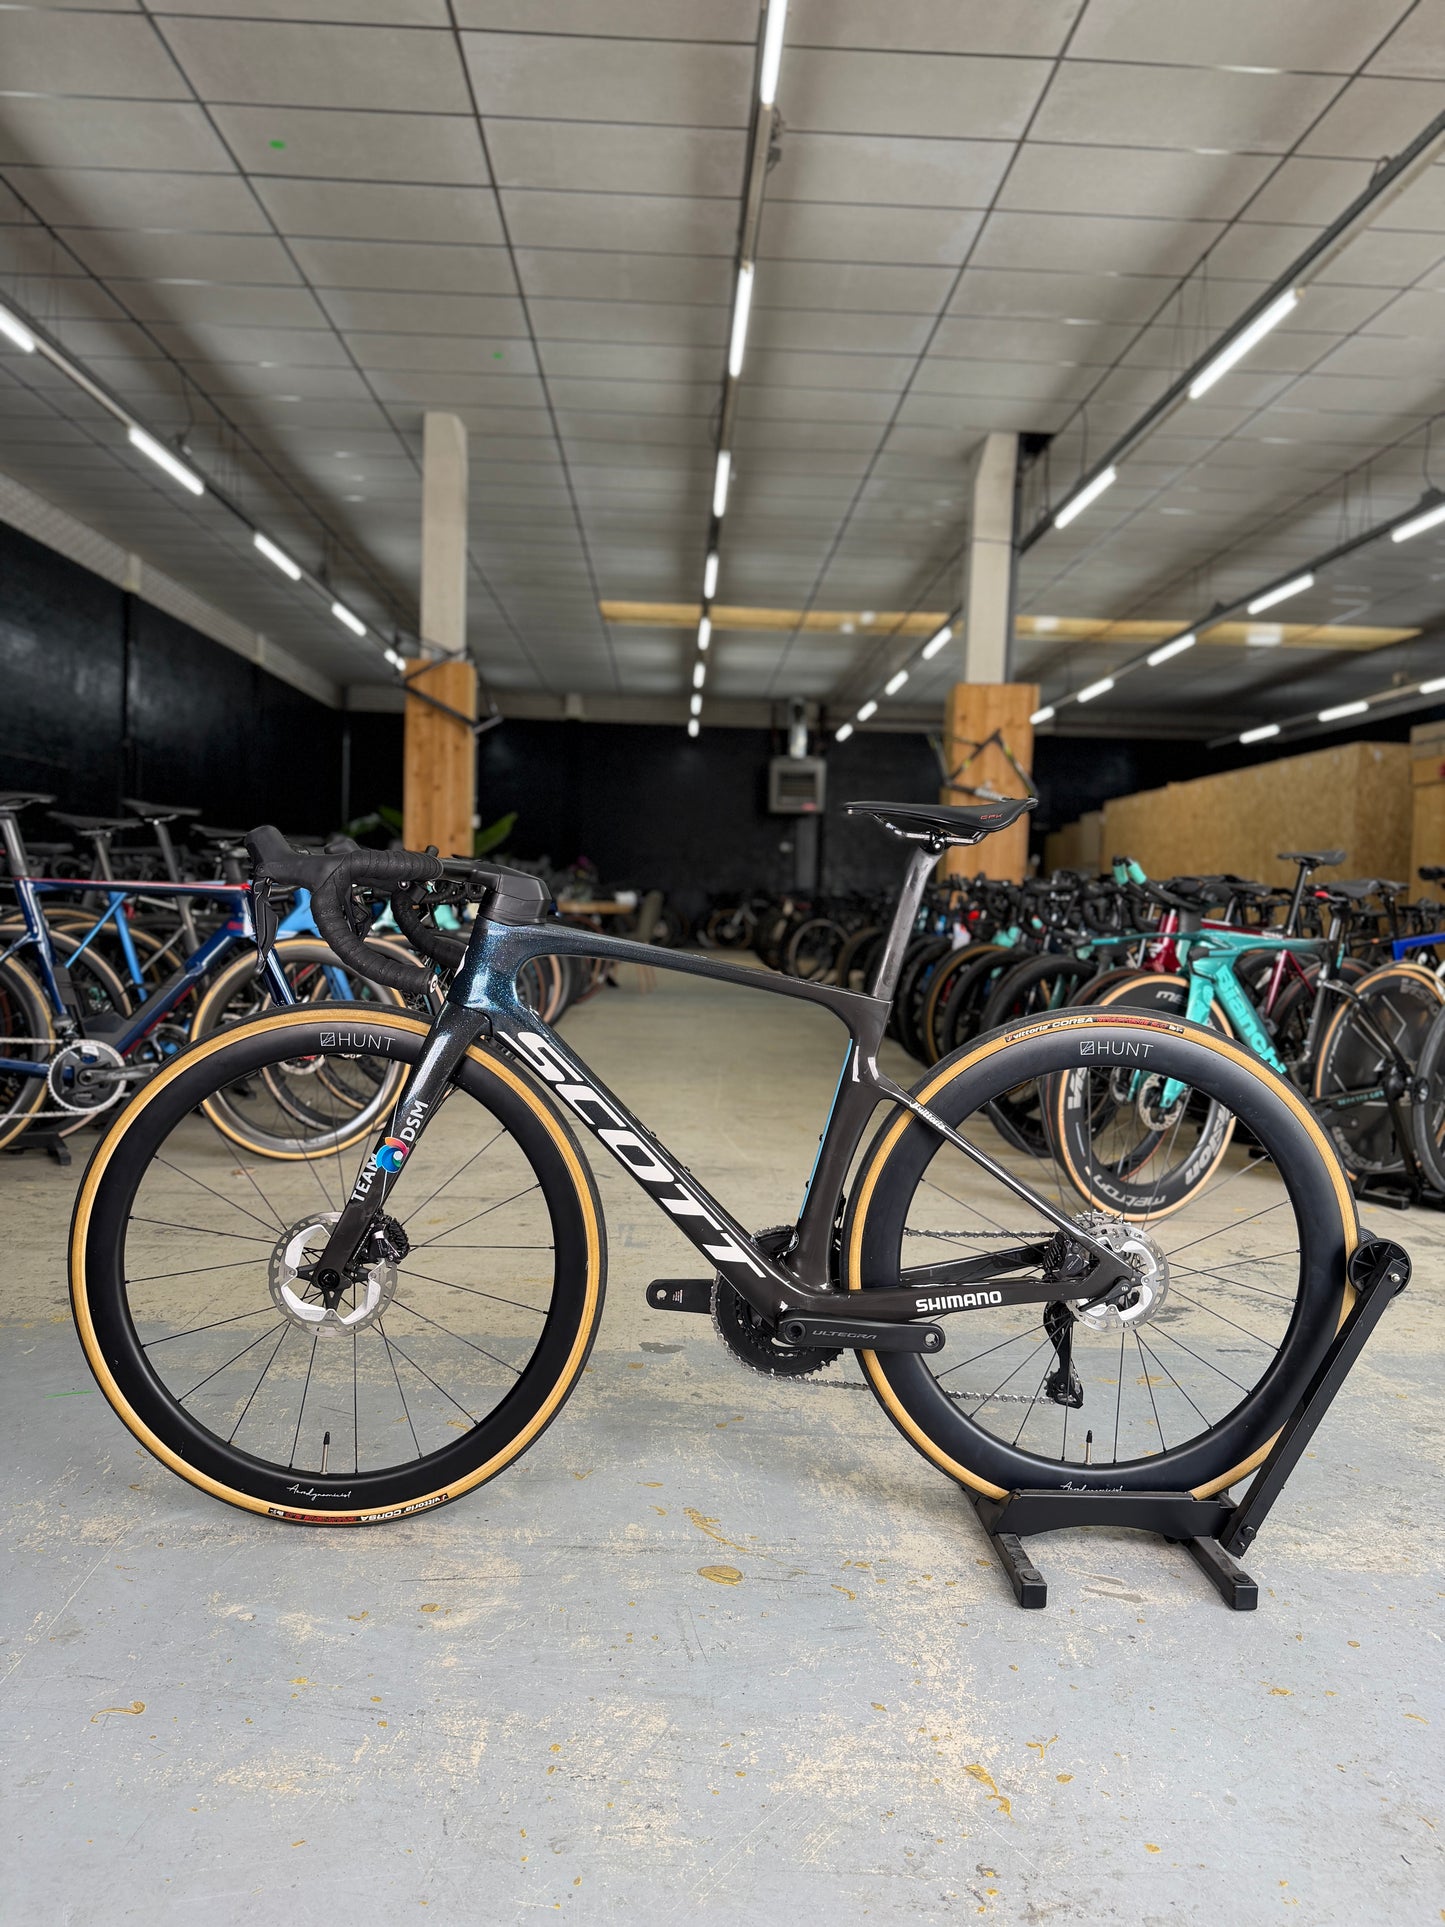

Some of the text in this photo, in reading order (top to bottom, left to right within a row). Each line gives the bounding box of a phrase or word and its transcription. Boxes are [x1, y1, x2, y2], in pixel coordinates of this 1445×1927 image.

[1013, 1023, 1050, 1040] vittoria
[1052, 1016, 1094, 1028] CORSA
[338, 1032, 396, 1052] HUNT
[1097, 1041, 1154, 1058] HUNT
[351, 1100, 429, 1202] TEAM DSM
[496, 1031, 767, 1278] SCOTT
[915, 1290, 1003, 1313] SHIMANO
[811, 1329, 878, 1341] ULTEGRA
[361, 1509, 402, 1522] CORSA
